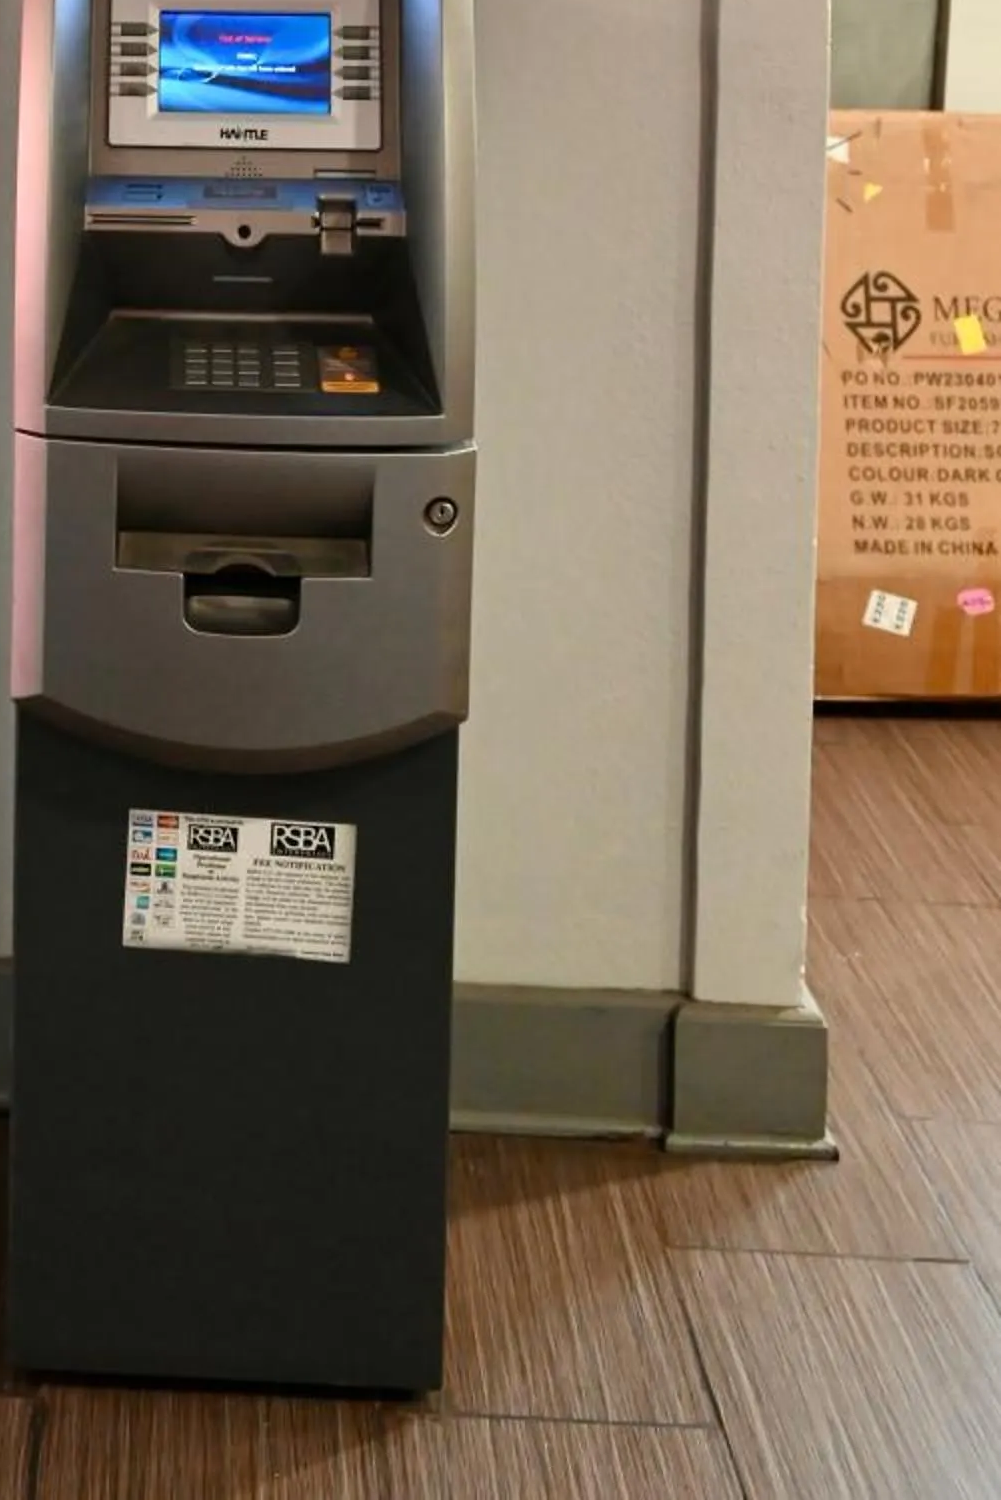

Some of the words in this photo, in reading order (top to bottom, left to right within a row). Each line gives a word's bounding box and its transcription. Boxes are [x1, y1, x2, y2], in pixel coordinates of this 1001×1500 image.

[844, 394, 887, 410] ITEM
[845, 418, 935, 434] PRODUCT
[930, 492, 970, 507] KGS
[931, 516, 971, 531] KGS
[854, 539, 909, 555] MADE
[914, 540, 933, 555] IN
[938, 540, 998, 556] CHINA
[190, 825, 236, 849] RSBA
[273, 825, 331, 852] RSBA
[275, 860, 346, 872] NOTIFICATION
